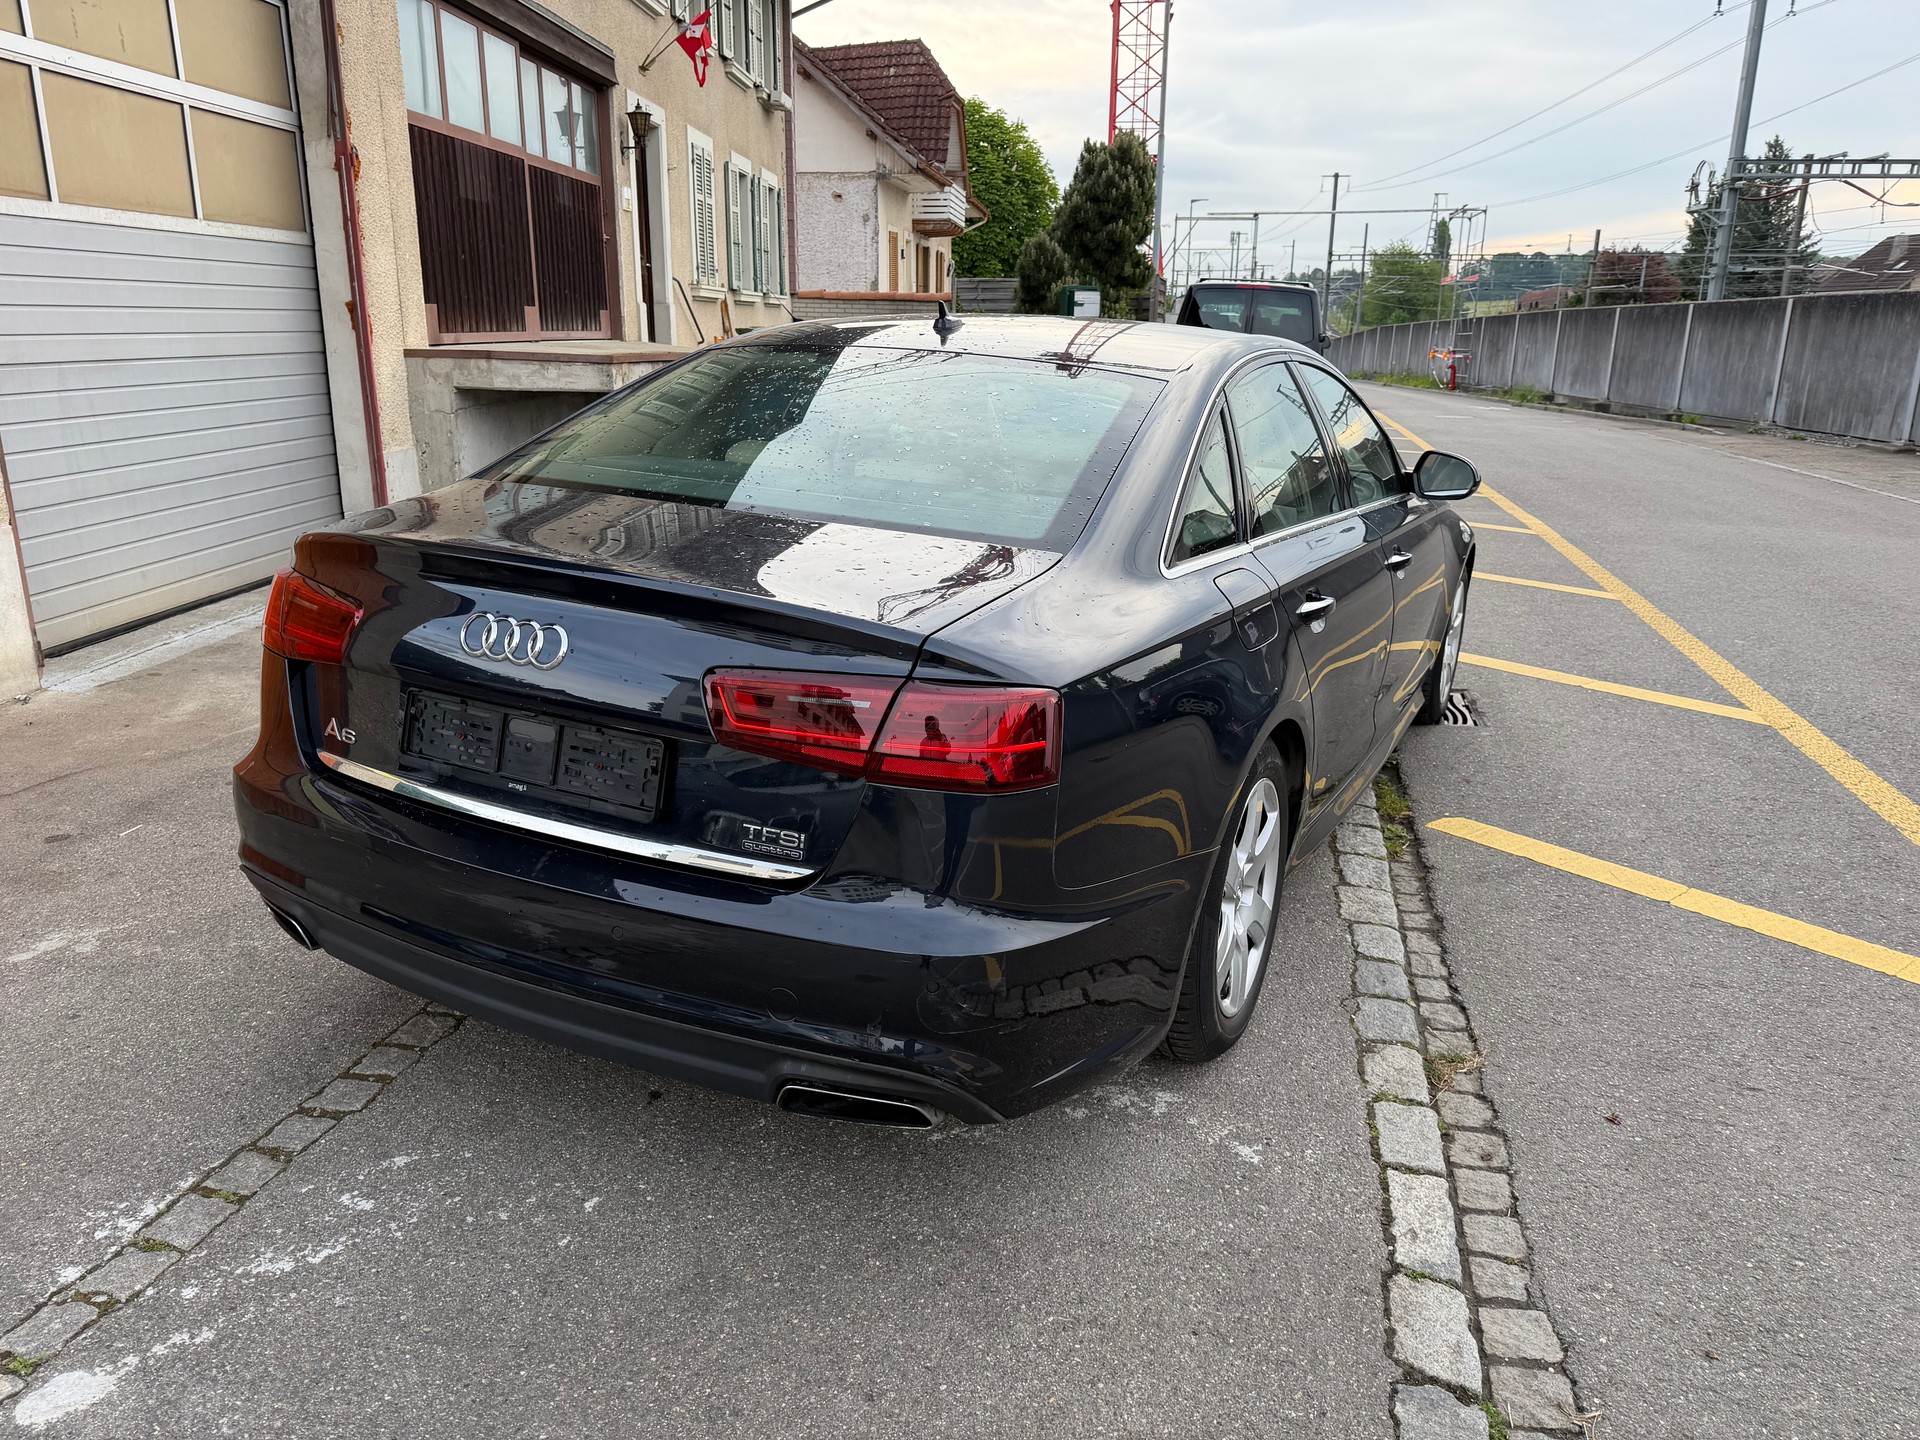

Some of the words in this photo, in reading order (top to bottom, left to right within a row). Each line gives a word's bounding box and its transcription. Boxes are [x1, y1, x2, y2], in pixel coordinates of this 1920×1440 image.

[324, 717, 356, 744] A6
[742, 823, 806, 849] TFSI
[743, 841, 801, 858] quattro
